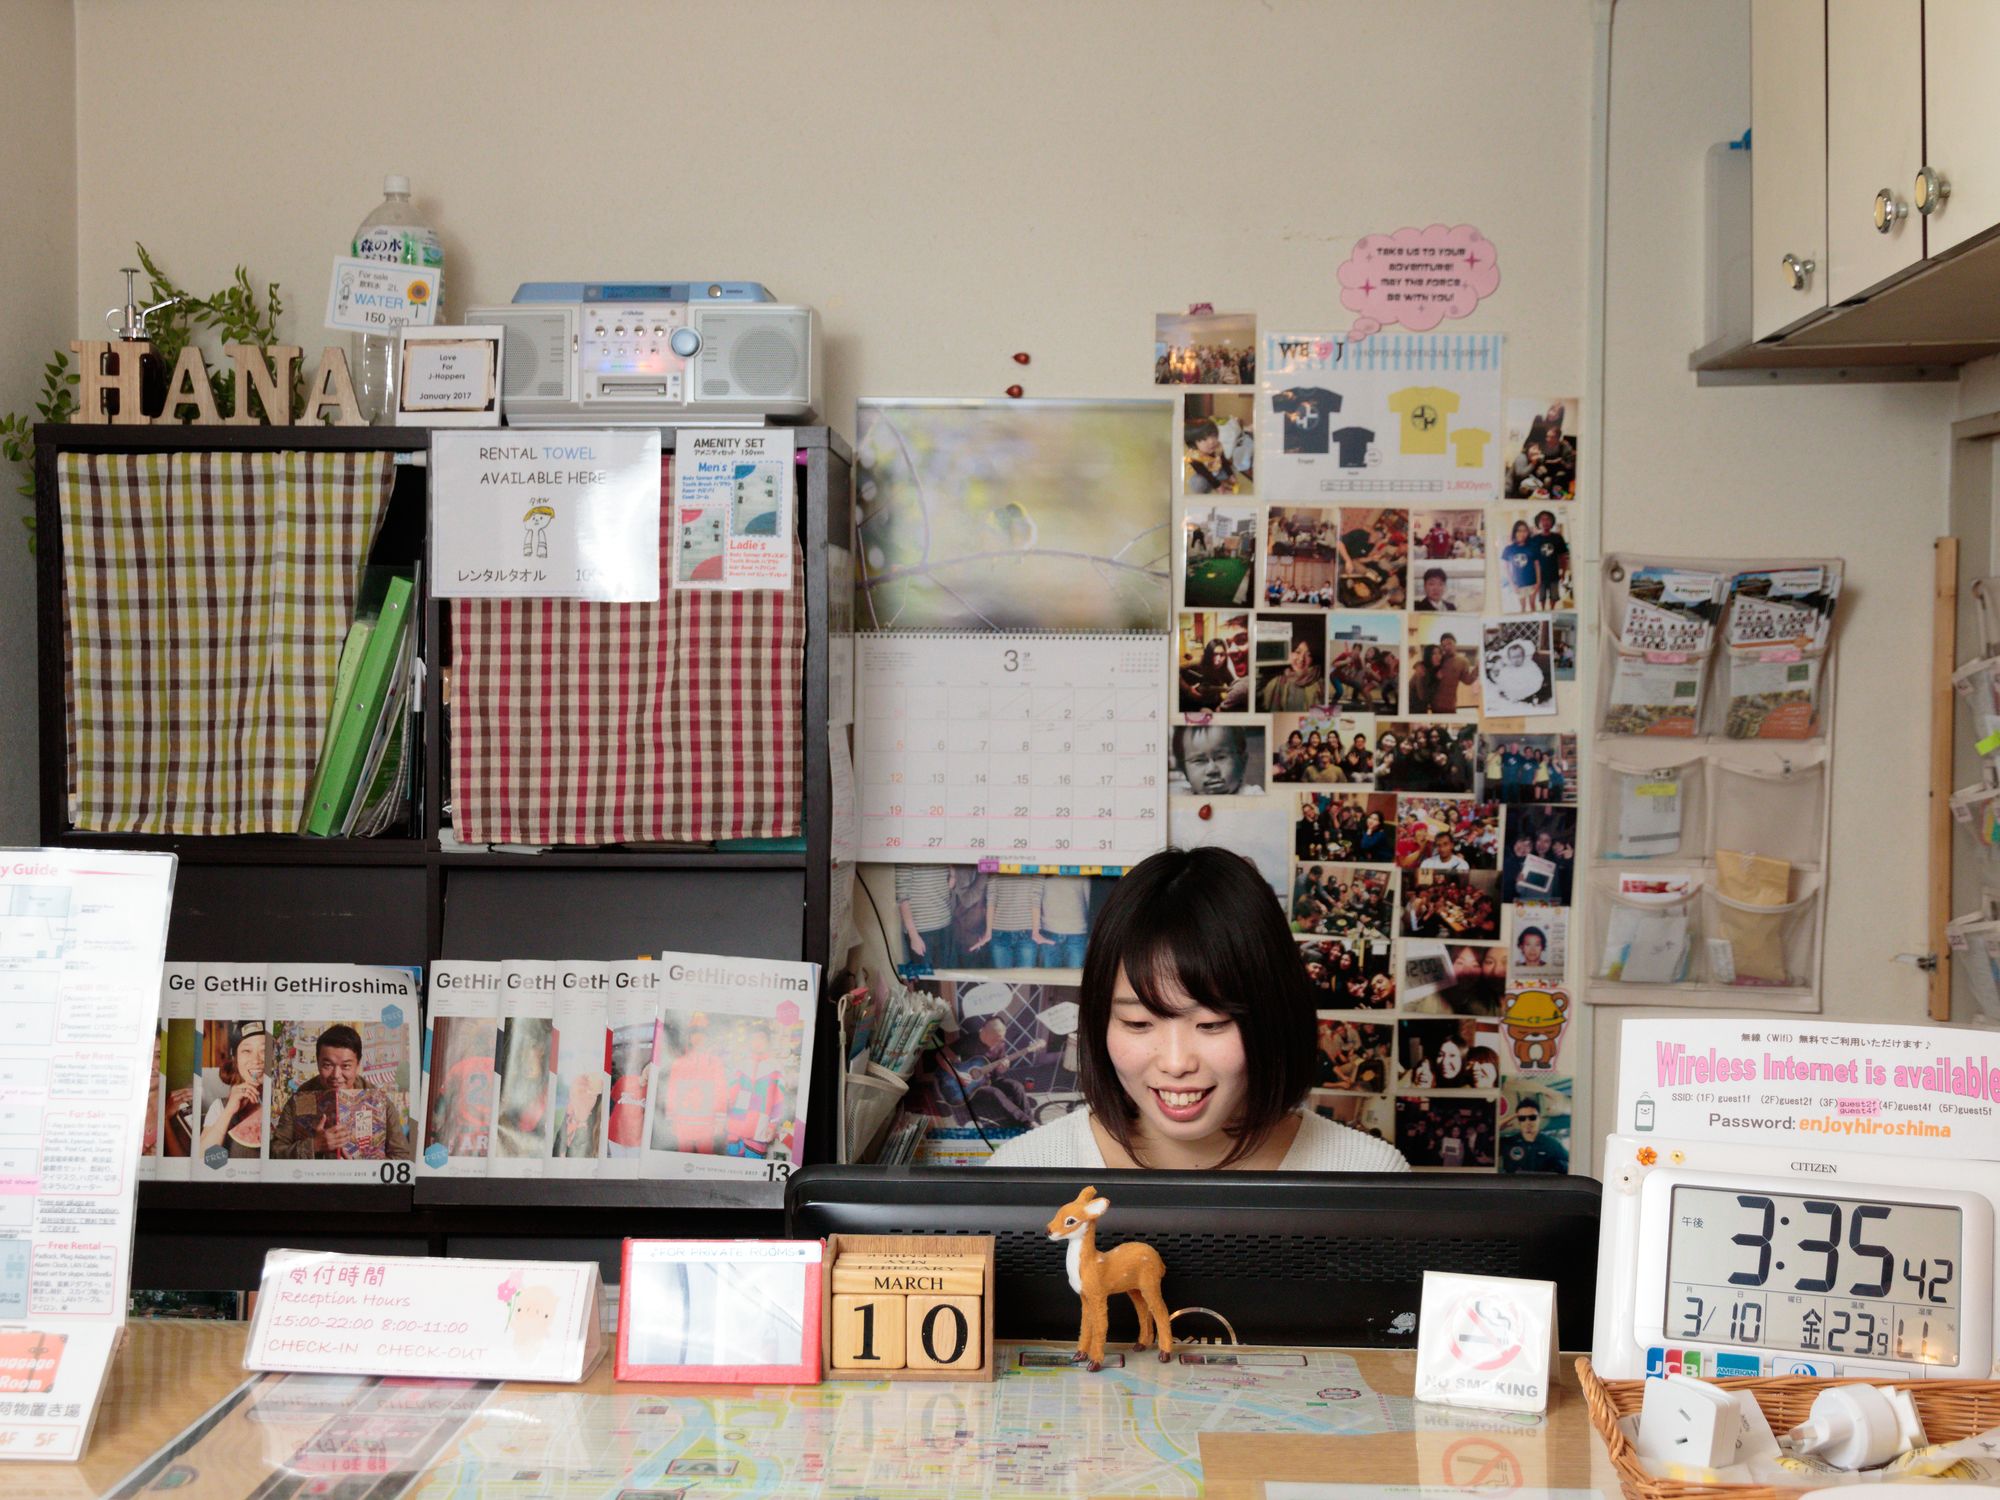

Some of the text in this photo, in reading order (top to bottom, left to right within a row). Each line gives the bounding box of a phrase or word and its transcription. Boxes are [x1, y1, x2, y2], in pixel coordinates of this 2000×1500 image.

[360, 238, 402, 253] 森の水
[354, 293, 404, 309] WATER
[365, 312, 409, 326] 150 yen
[70, 340, 370, 427] HANA
[428, 373, 466, 381] J-Hoppers
[420, 392, 472, 401] January 2017
[694, 438, 765, 448] AMENITY SET
[480, 447, 596, 460] RENTAL TOWEL
[480, 472, 606, 485] AVAILABLE HERE
[458, 569, 547, 582] レンタルタオル
[1003, 650, 1019, 672] 3
[1024, 709, 1156, 720] 1 2 3 4
[1101, 742, 1114, 752] 10
[1145, 743, 1157, 753] 11
[890, 773, 1156, 786] 12 13 14 15 16 17 18
[889, 806, 1155, 818] 19 20 21 22 23 24 25
[886, 837, 1113, 849] 26 27 28 29 30 31
[13, 862, 58, 876] Guide
[669, 964, 808, 991] GetHiroshima
[274, 976, 408, 996] GetHiroshima
[1656, 1040, 2000, 1103] Wireless Internet is available
[1672, 1093, 1693, 1102] SSID:
[1696, 1093, 1715, 1104] (1F)
[1709, 1113, 1951, 1138] Password: enjoyhiroshima
[1790, 1161, 1838, 1174] CITIZEN
[1681, 1216, 1704, 1230] 午後
[49, 1241, 101, 1250] Free Rental
[660, 1246, 796, 1257] FOR PRIVATE ROOMS
[1728, 1195, 1953, 1304] 3:35 42
[290, 1265, 386, 1288] 受付時間
[874, 1276, 944, 1291] MARCH
[281, 1291, 411, 1309] Reception Hours
[274, 1315, 469, 1334] 15:00-22:00 8:00-11:00
[1800, 1308, 1824, 1351] 金
[269, 1339, 488, 1361] CHECK-IN CHECK-OUT
[1716, 1366, 1757, 1378] AMERICAN
[34, 1431, 60, 1447] 5F
